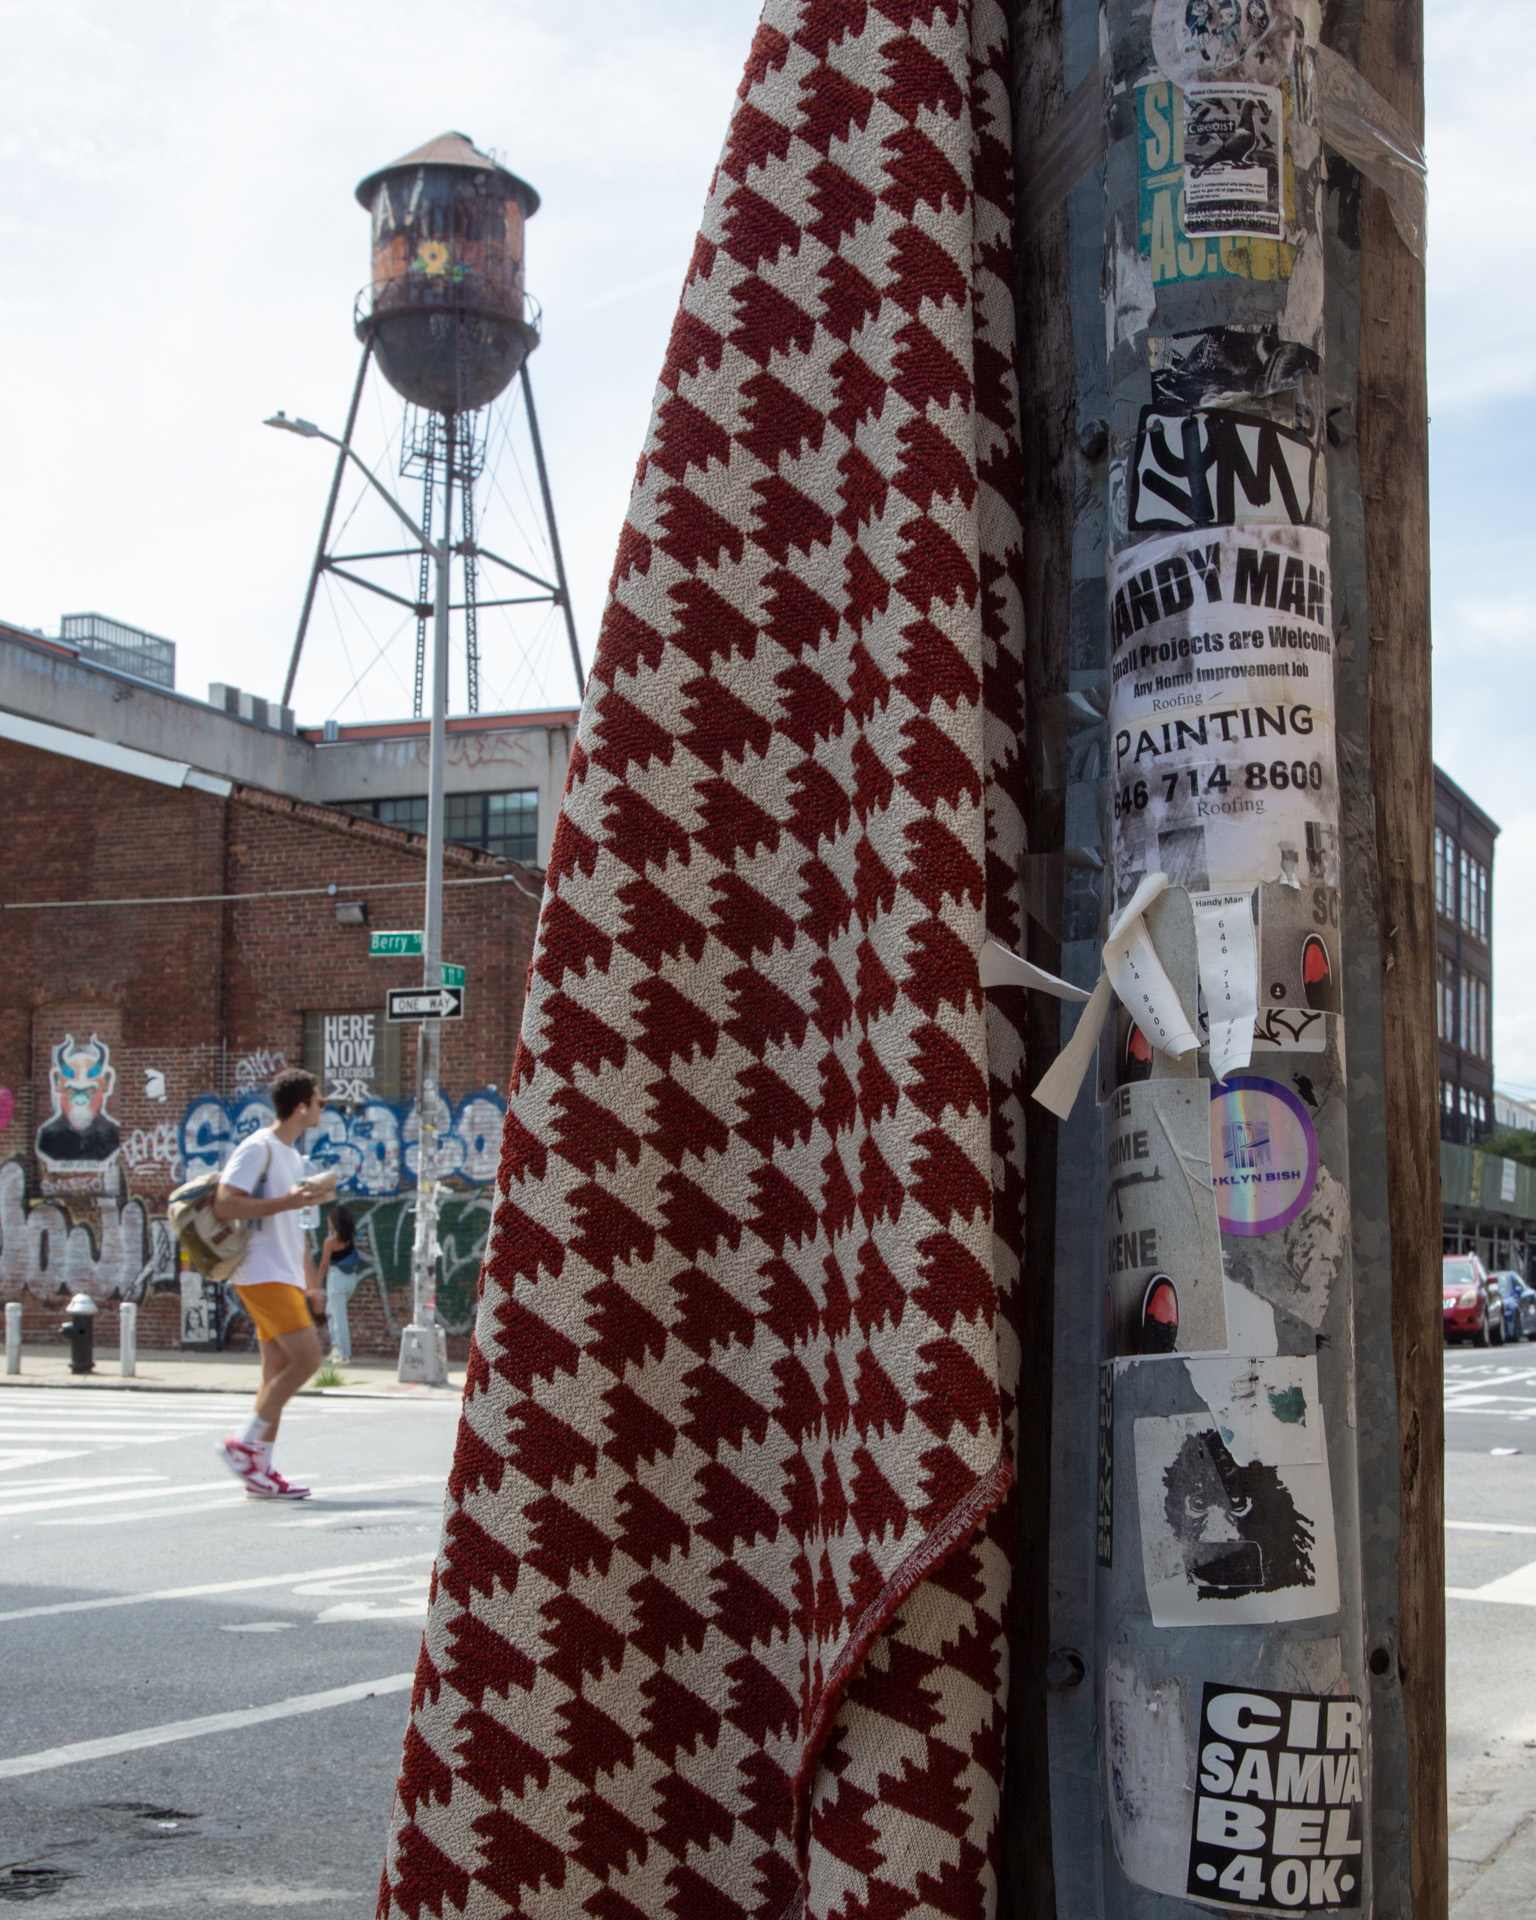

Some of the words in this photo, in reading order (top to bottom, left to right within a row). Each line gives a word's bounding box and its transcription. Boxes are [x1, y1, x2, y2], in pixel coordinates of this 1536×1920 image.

[1111, 541, 1223, 655] ANDY
[1233, 547, 1325, 627] MAN
[1140, 631, 1225, 668] Projects
[1229, 629, 1264, 650] are
[1267, 625, 1331, 655] Welcome
[1133, 681, 1153, 699] Any
[1155, 670, 1194, 692] Home
[1197, 662, 1290, 683] Improvement
[1291, 662, 1309, 678] Job
[1152, 692, 1203, 712] Roofing
[1115, 704, 1314, 775] PAINTING
[1114, 780, 1149, 821] 646
[1161, 764, 1231, 804] 714
[1245, 760, 1323, 791] 8600
[1196, 797, 1266, 818] Roofing
[1195, 899, 1222, 909] Handy
[1224, 896, 1244, 905] Man
[371, 934, 408, 953] Berry
[398, 999, 419, 1011] ONE
[429, 997, 450, 1009] WAY
[325, 1014, 375, 1041] HERE
[325, 1040, 375, 1067] NOW
[325, 1068, 337, 1079] NO
[338, 1067, 375, 1079] EXCUSES
[1265, 1171, 1301, 1182] BISH
[1206, 1692, 1362, 1749] CIR
[1200, 1742, 1363, 1804] SAMVA
[1196, 1796, 1362, 1856] BEL
